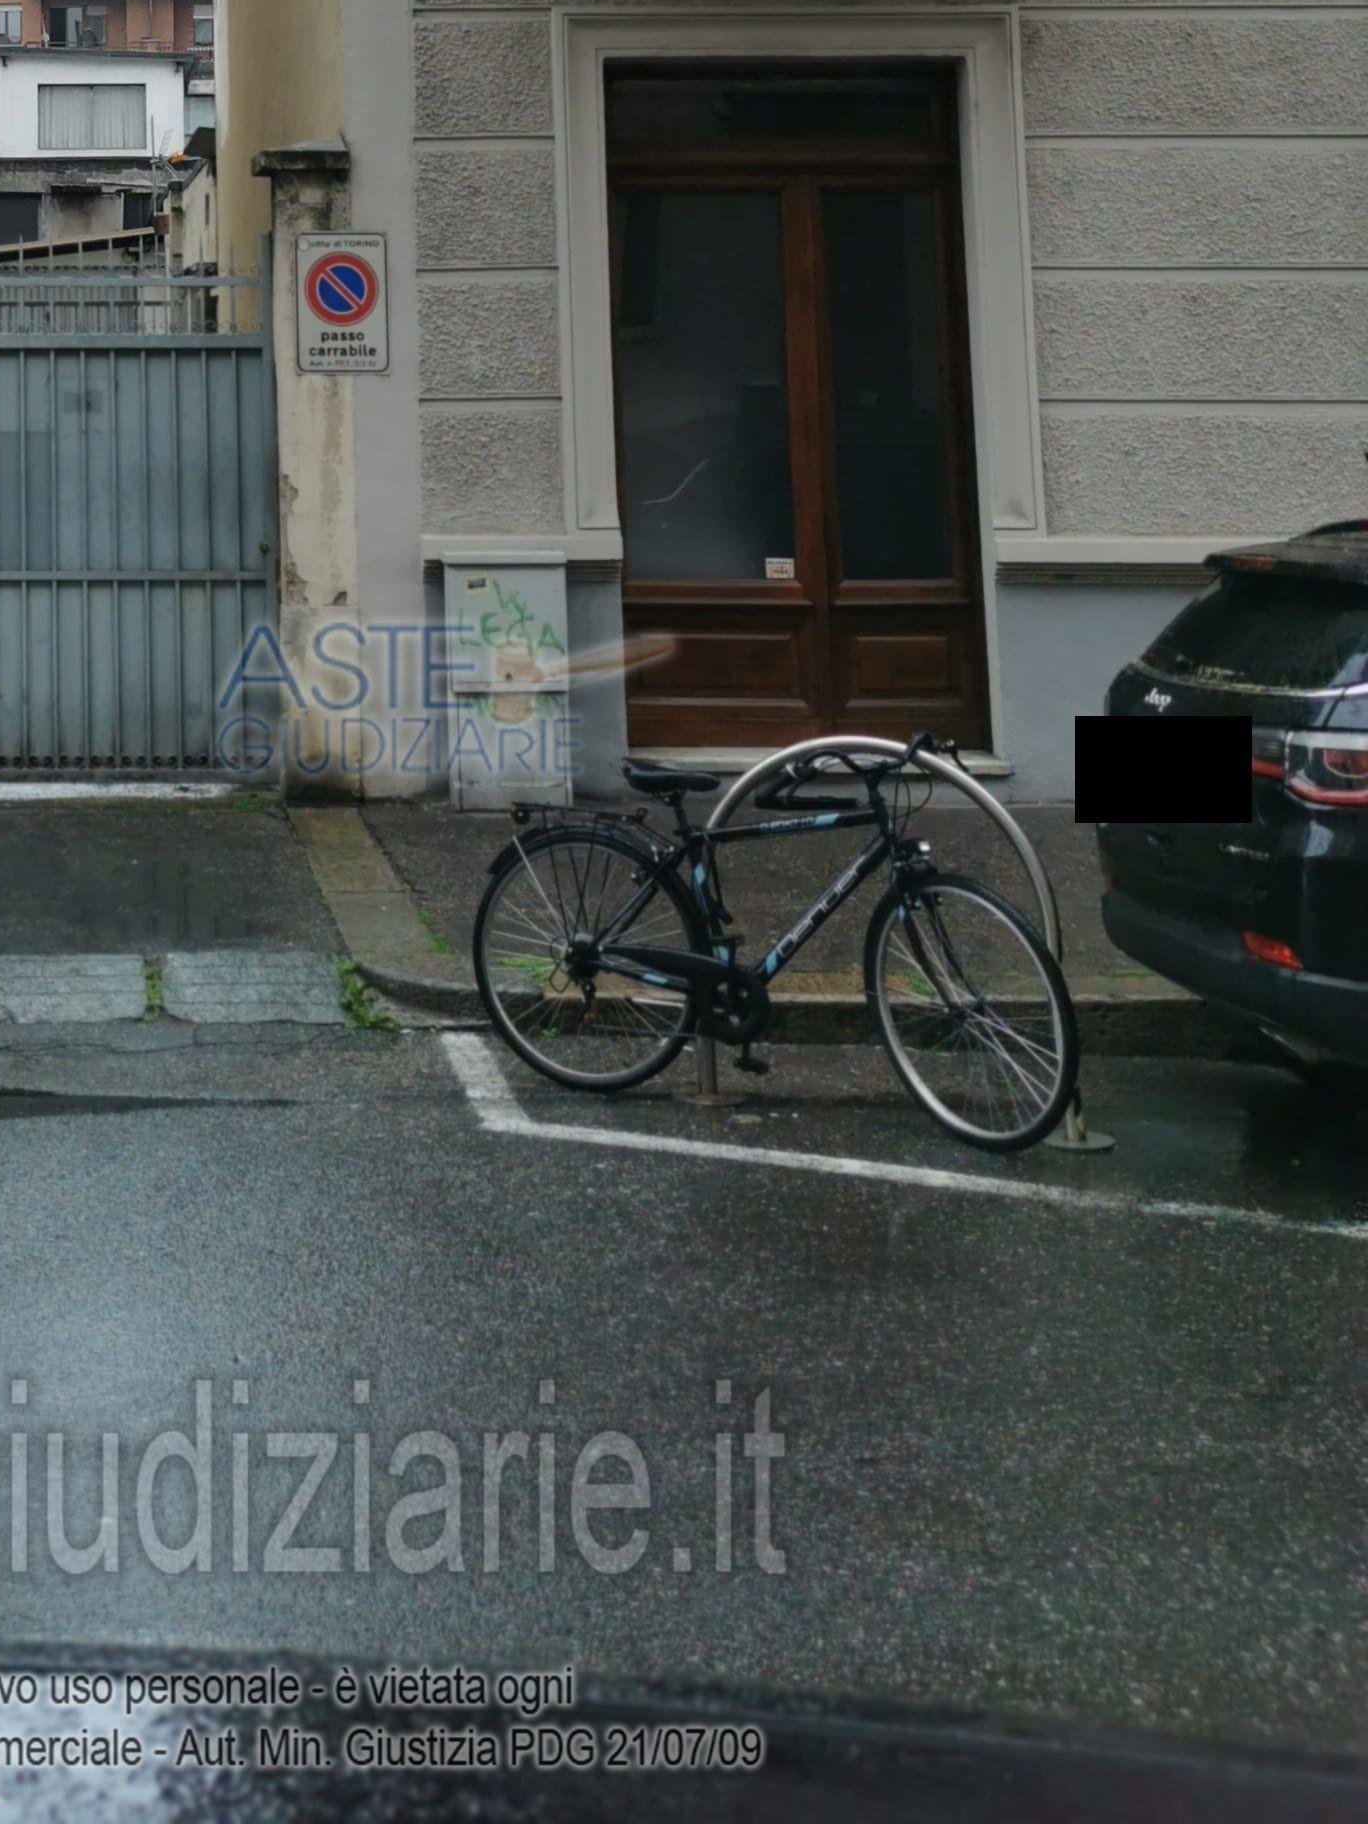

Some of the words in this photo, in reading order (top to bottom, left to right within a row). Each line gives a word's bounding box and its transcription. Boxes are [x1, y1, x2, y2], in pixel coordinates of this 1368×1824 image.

[344, 239, 380, 248] TORINO
[321, 331, 364, 343] passo
[309, 344, 377, 357] carrabile
